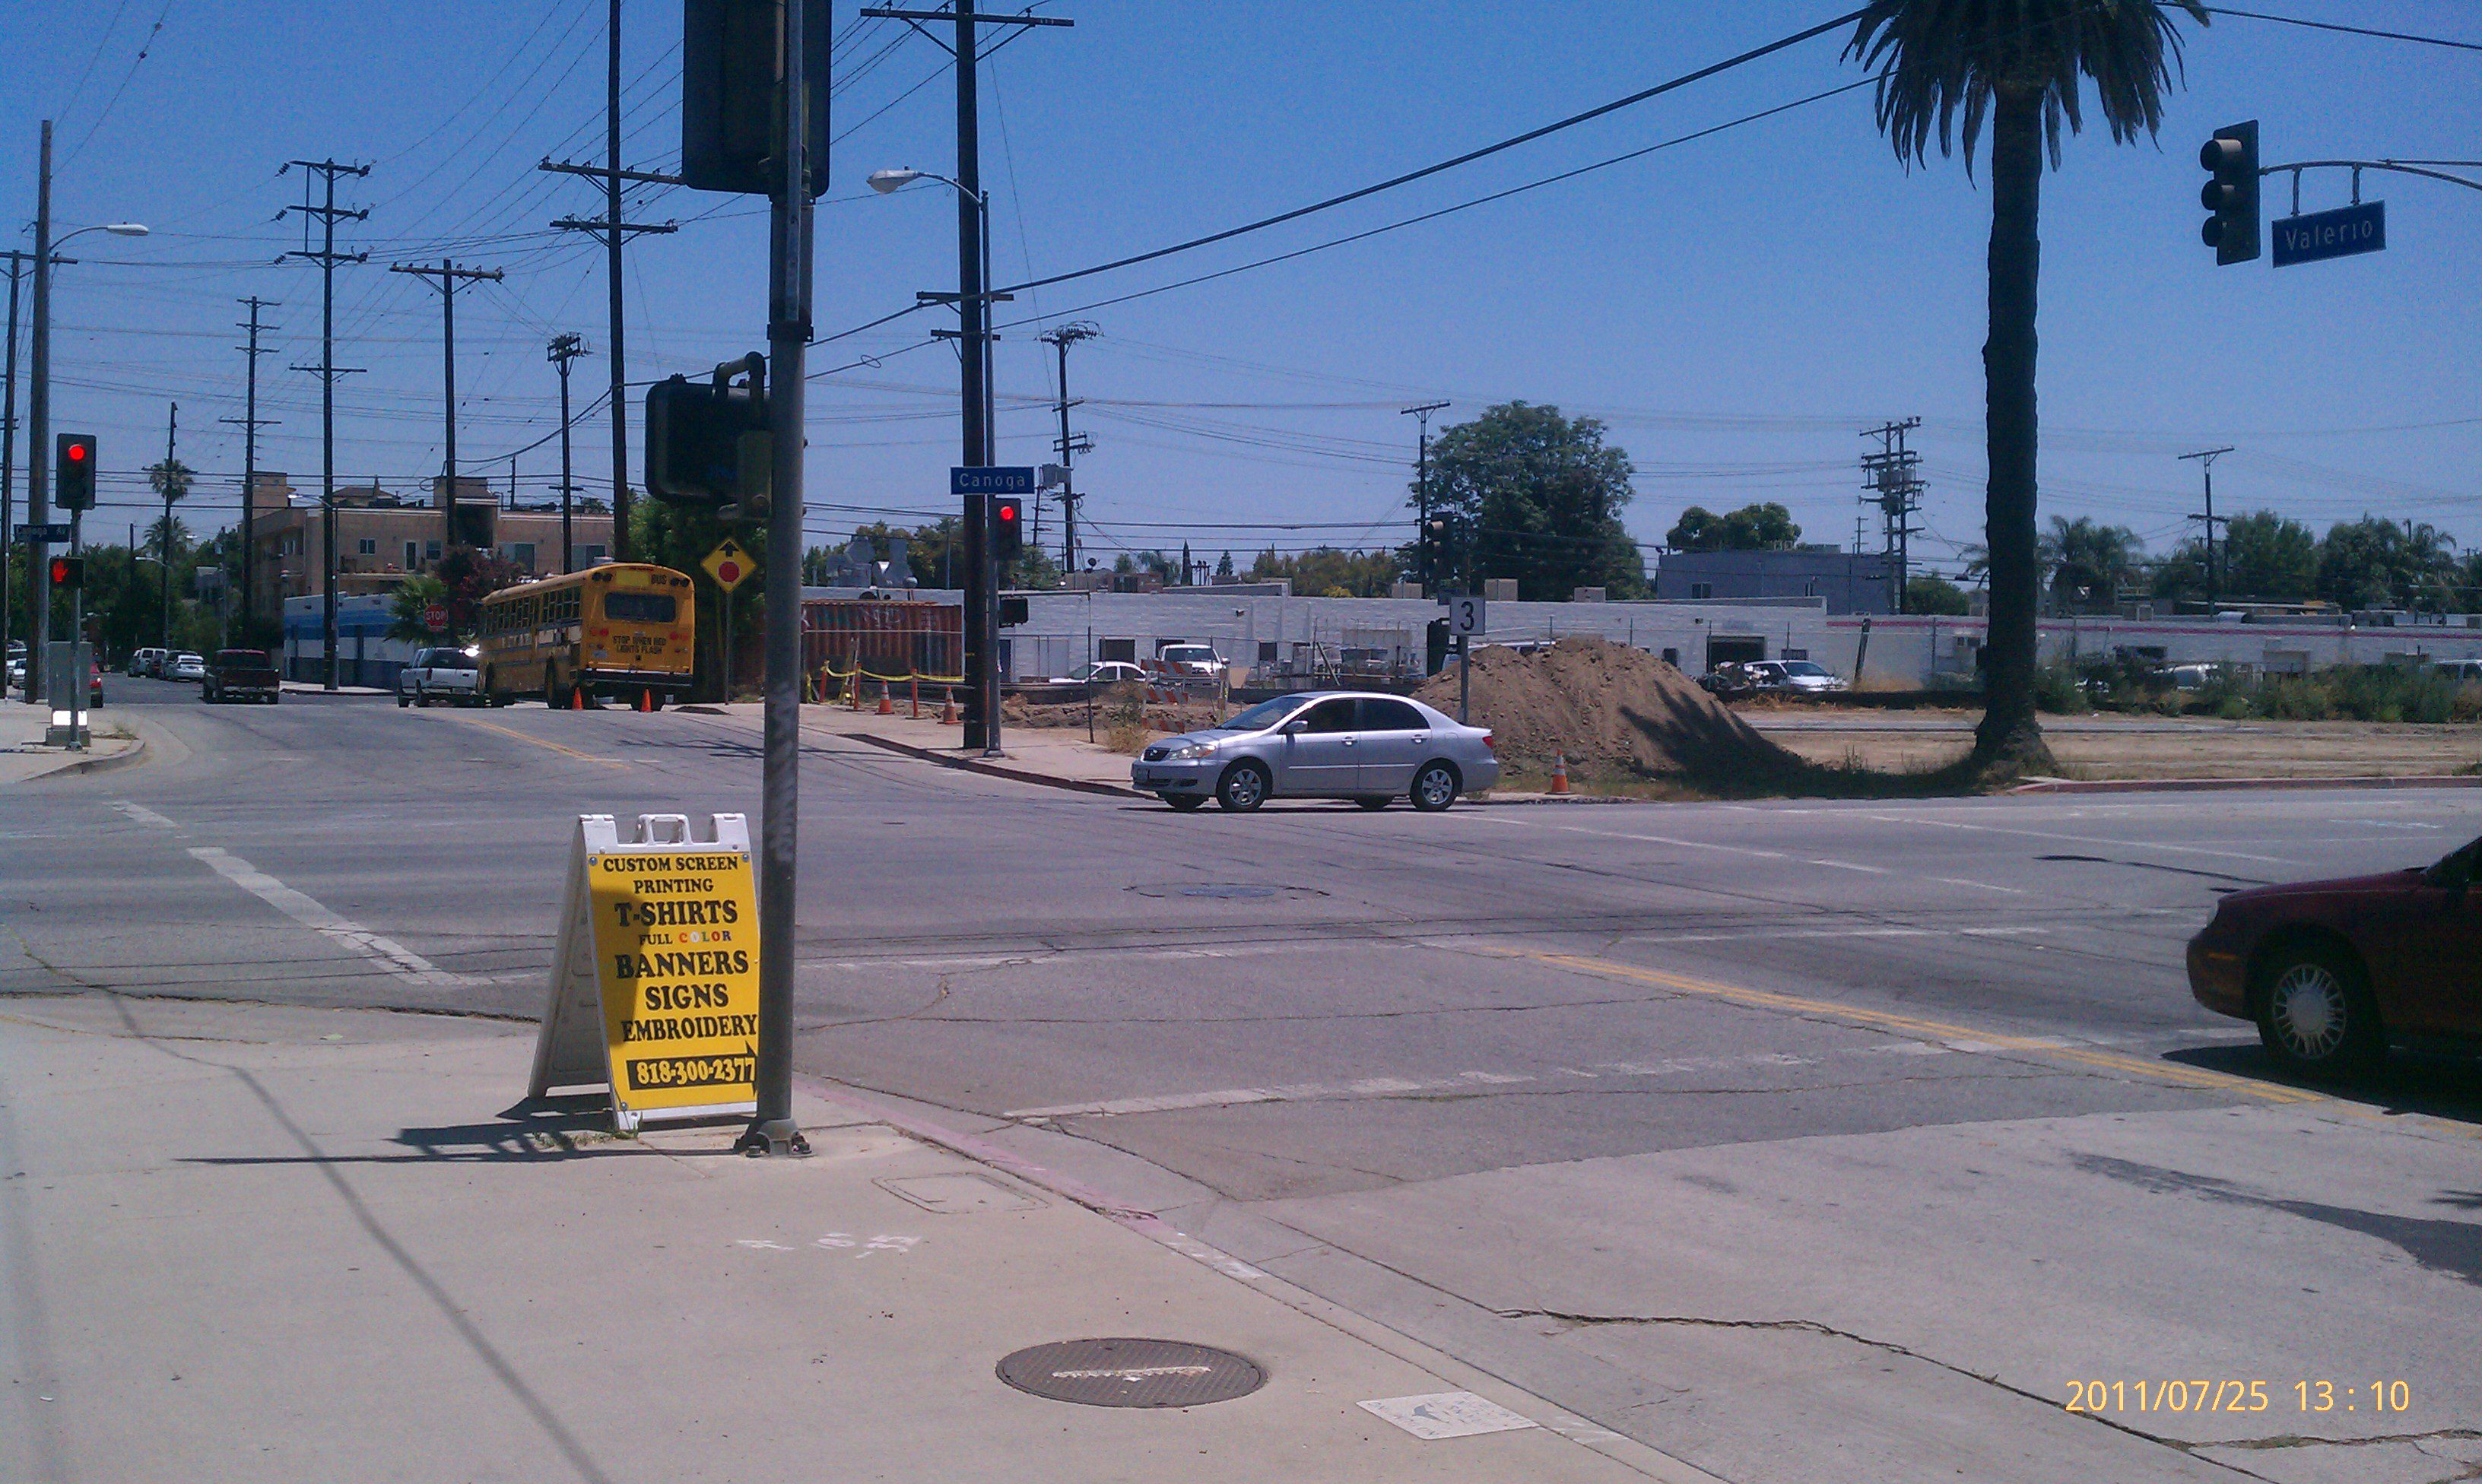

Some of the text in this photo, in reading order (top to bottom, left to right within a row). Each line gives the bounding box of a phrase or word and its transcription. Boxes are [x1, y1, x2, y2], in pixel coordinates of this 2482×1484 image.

[2284, 220, 2372, 251] Valerio
[959, 473, 1025, 490] Canoga
[651, 574, 667, 585] BUS
[426, 610, 447, 620] STOP
[1460, 601, 1474, 631] 3
[613, 636, 630, 645] STOP
[603, 856, 738, 872] CUSTOM SCREEN
[633, 878, 714, 894] PRINTING
[614, 899, 738, 927] T-SHIRTS
[639, 931, 732, 945] FULL COLOR
[615, 950, 749, 978] BANNERS
[646, 983, 728, 1010] SIGNS
[621, 1014, 757, 1042] EMBROIDERY
[636, 1058, 756, 1085] 818-300-2377
